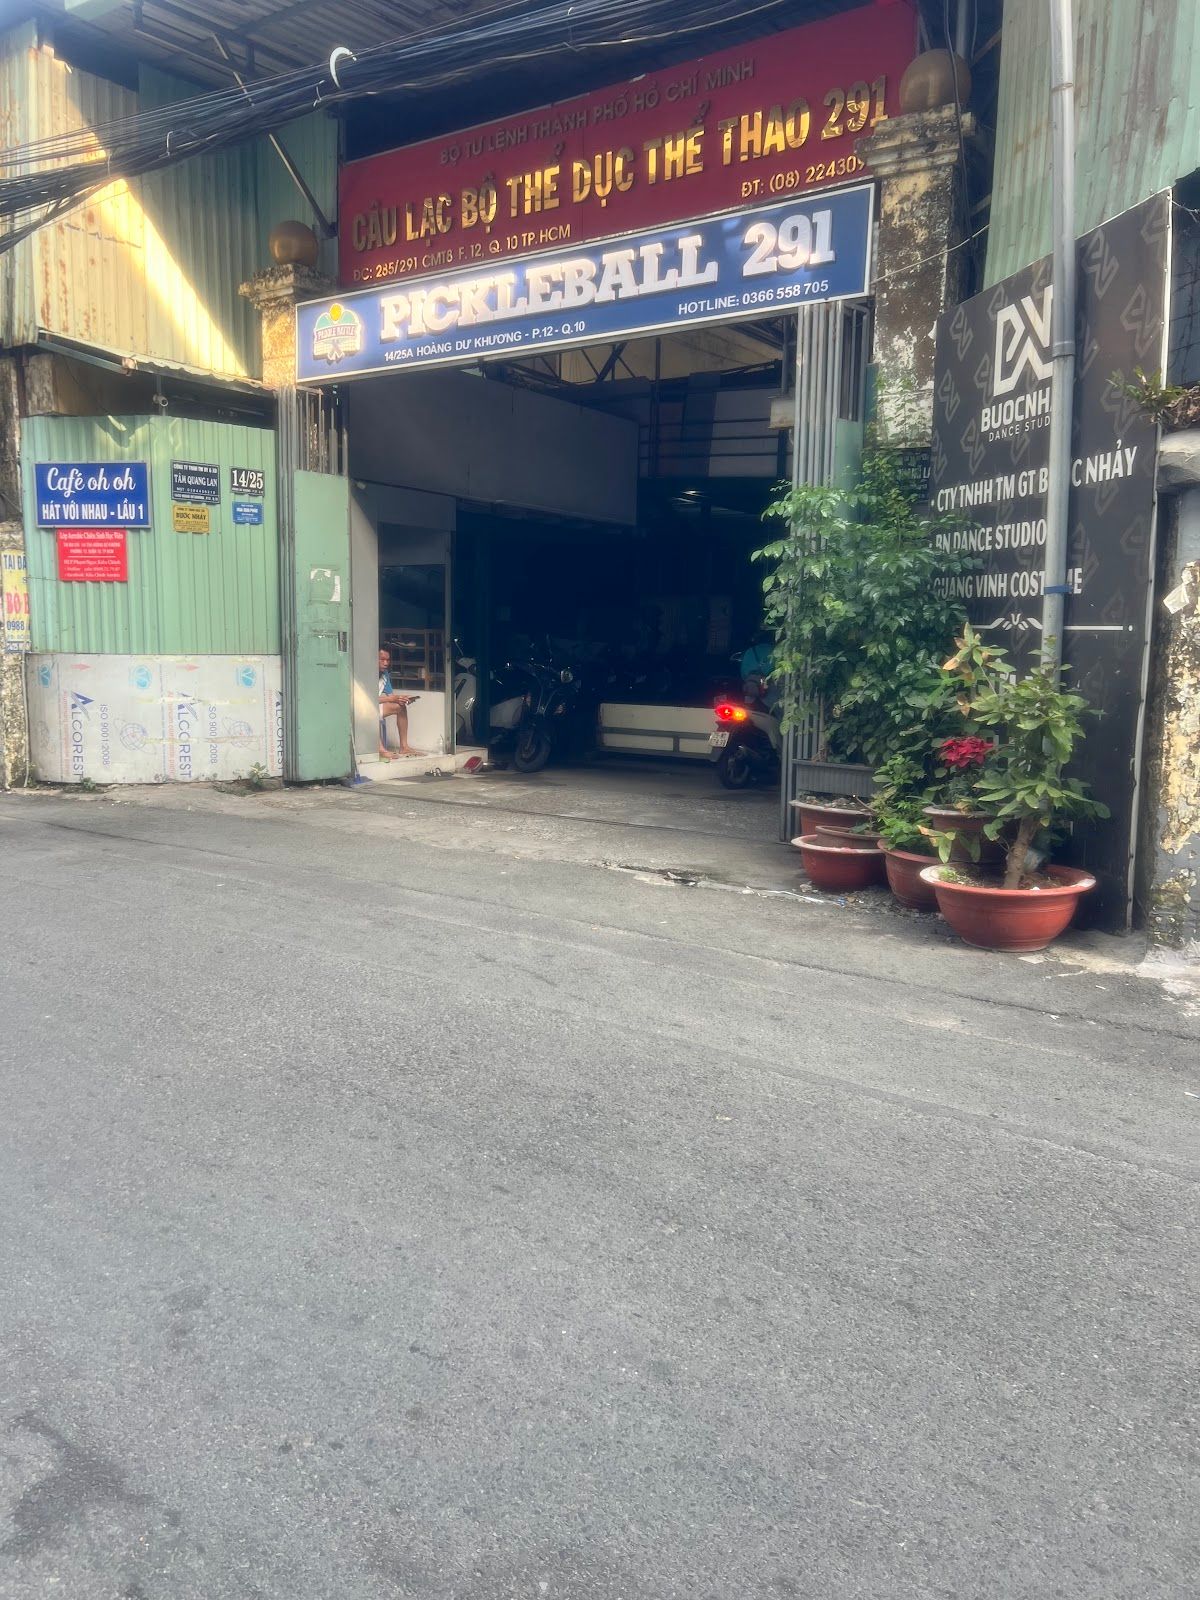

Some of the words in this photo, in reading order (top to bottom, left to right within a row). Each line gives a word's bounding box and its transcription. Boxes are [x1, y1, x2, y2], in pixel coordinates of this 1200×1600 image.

[705, 60, 755, 90] MINH
[406, 193, 451, 247] LẠC
[462, 171, 497, 234] BỘ
[506, 141, 564, 218] THỂ
[572, 148, 634, 208] DỤC
[644, 102, 710, 185] THỂ
[718, 97, 810, 166] THAO
[821, 75, 889, 140] 291
[770, 170, 800, 193] (08)
[422, 250, 453, 268] CMT8
[458, 247, 468, 260] F.
[489, 240, 503, 254] Q.
[506, 236, 518, 250] 10
[380, 234, 718, 341] PICKLEBALL
[743, 210, 835, 277] 291
[678, 296, 740, 315] HOTLINE:
[742, 289, 774, 305] 0366
[776, 284, 801, 300] 558
[804, 280, 829, 295] 705
[384, 346, 414, 362] 14/25A
[416, 340, 452, 356] HOÀNG
[456, 340, 472, 351] DƯ
[474, 330, 522, 348] KHƯƠNG
[532, 326, 554, 338] P.12
[562, 320, 586, 336] Q.10
[980, 387, 1052, 432] BUOCNH
[988, 424, 1020, 442] DANCE
[47, 468, 85, 498] Café
[88, 468, 110, 490] oh
[113, 468, 136, 490] oh
[232, 470, 264, 489] 14/25
[937, 487, 958, 512] CTY
[959, 478, 993, 508] TNHH
[996, 474, 1015, 501] TM
[1018, 470, 1036, 498] GT
[1085, 439, 1138, 484] NHẢY
[42, 500, 60, 520] HÁT
[62, 500, 79, 520] VỚI
[82, 504, 108, 520] NHAU
[118, 498, 136, 520] LẦU
[138, 504, 144, 520] 1
[952, 527, 993, 552] DANCE
[995, 518, 1048, 550] STUDIO
[976, 573, 1008, 598] VINH
